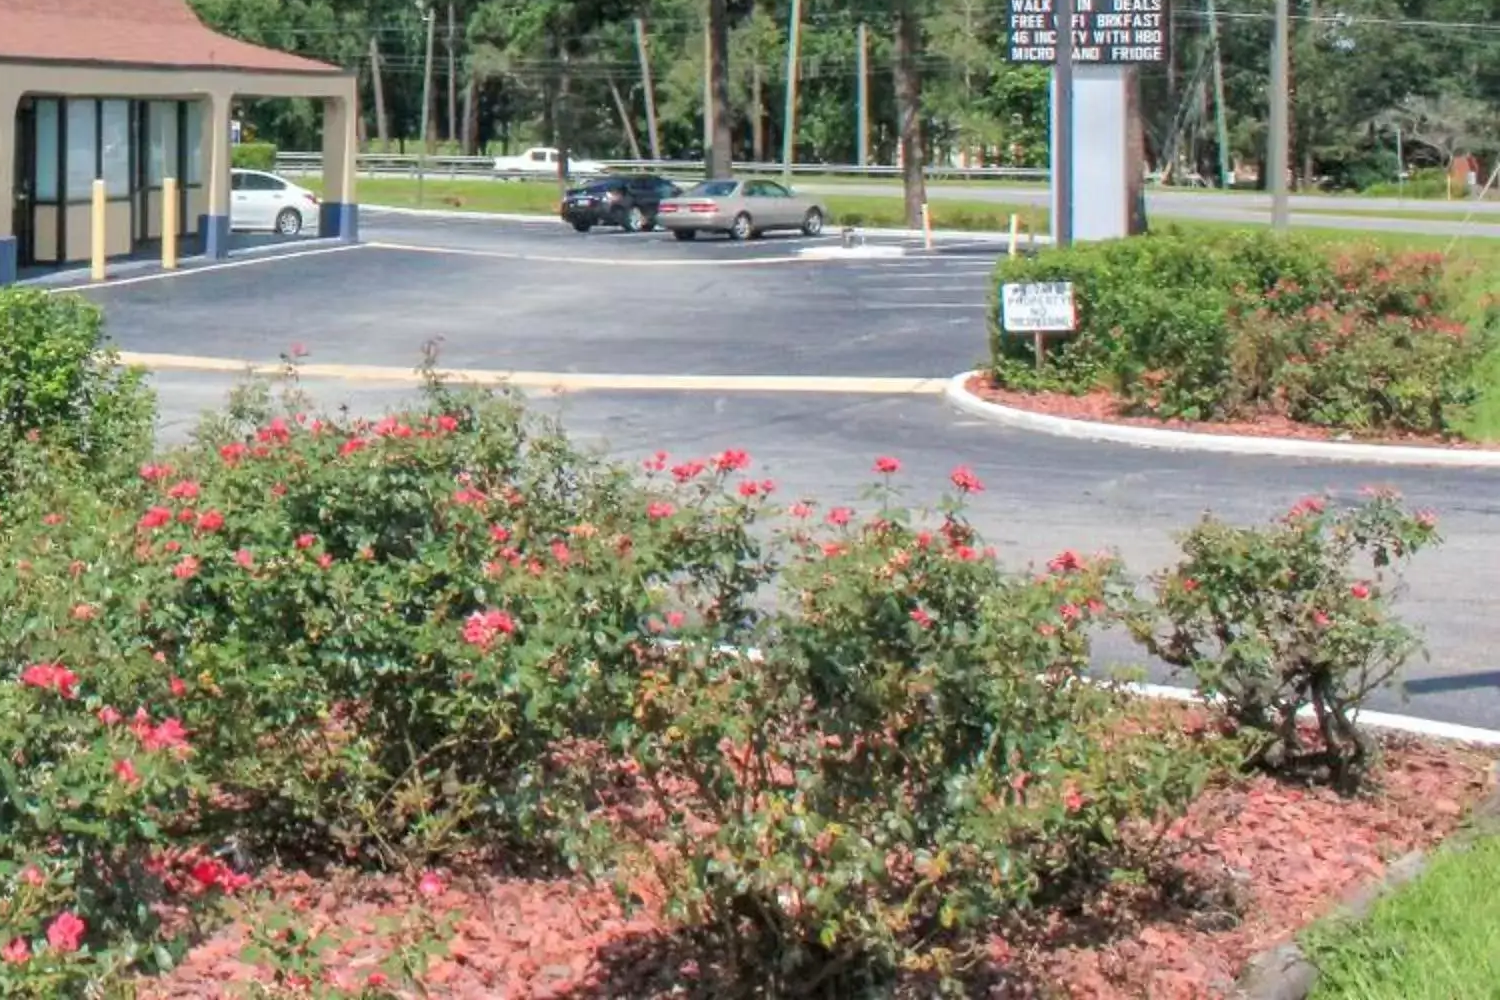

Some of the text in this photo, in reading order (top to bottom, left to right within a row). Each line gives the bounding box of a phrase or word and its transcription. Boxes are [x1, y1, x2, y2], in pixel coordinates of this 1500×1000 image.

[1011, 14, 1045, 29] FREE
[1097, 13, 1162, 28] BRKFAST
[1011, 31, 1030, 45] 46
[1093, 30, 1131, 45] WITH
[1135, 30, 1163, 44] HBO
[1011, 46, 1164, 61] MICRO AND FRIDGE
